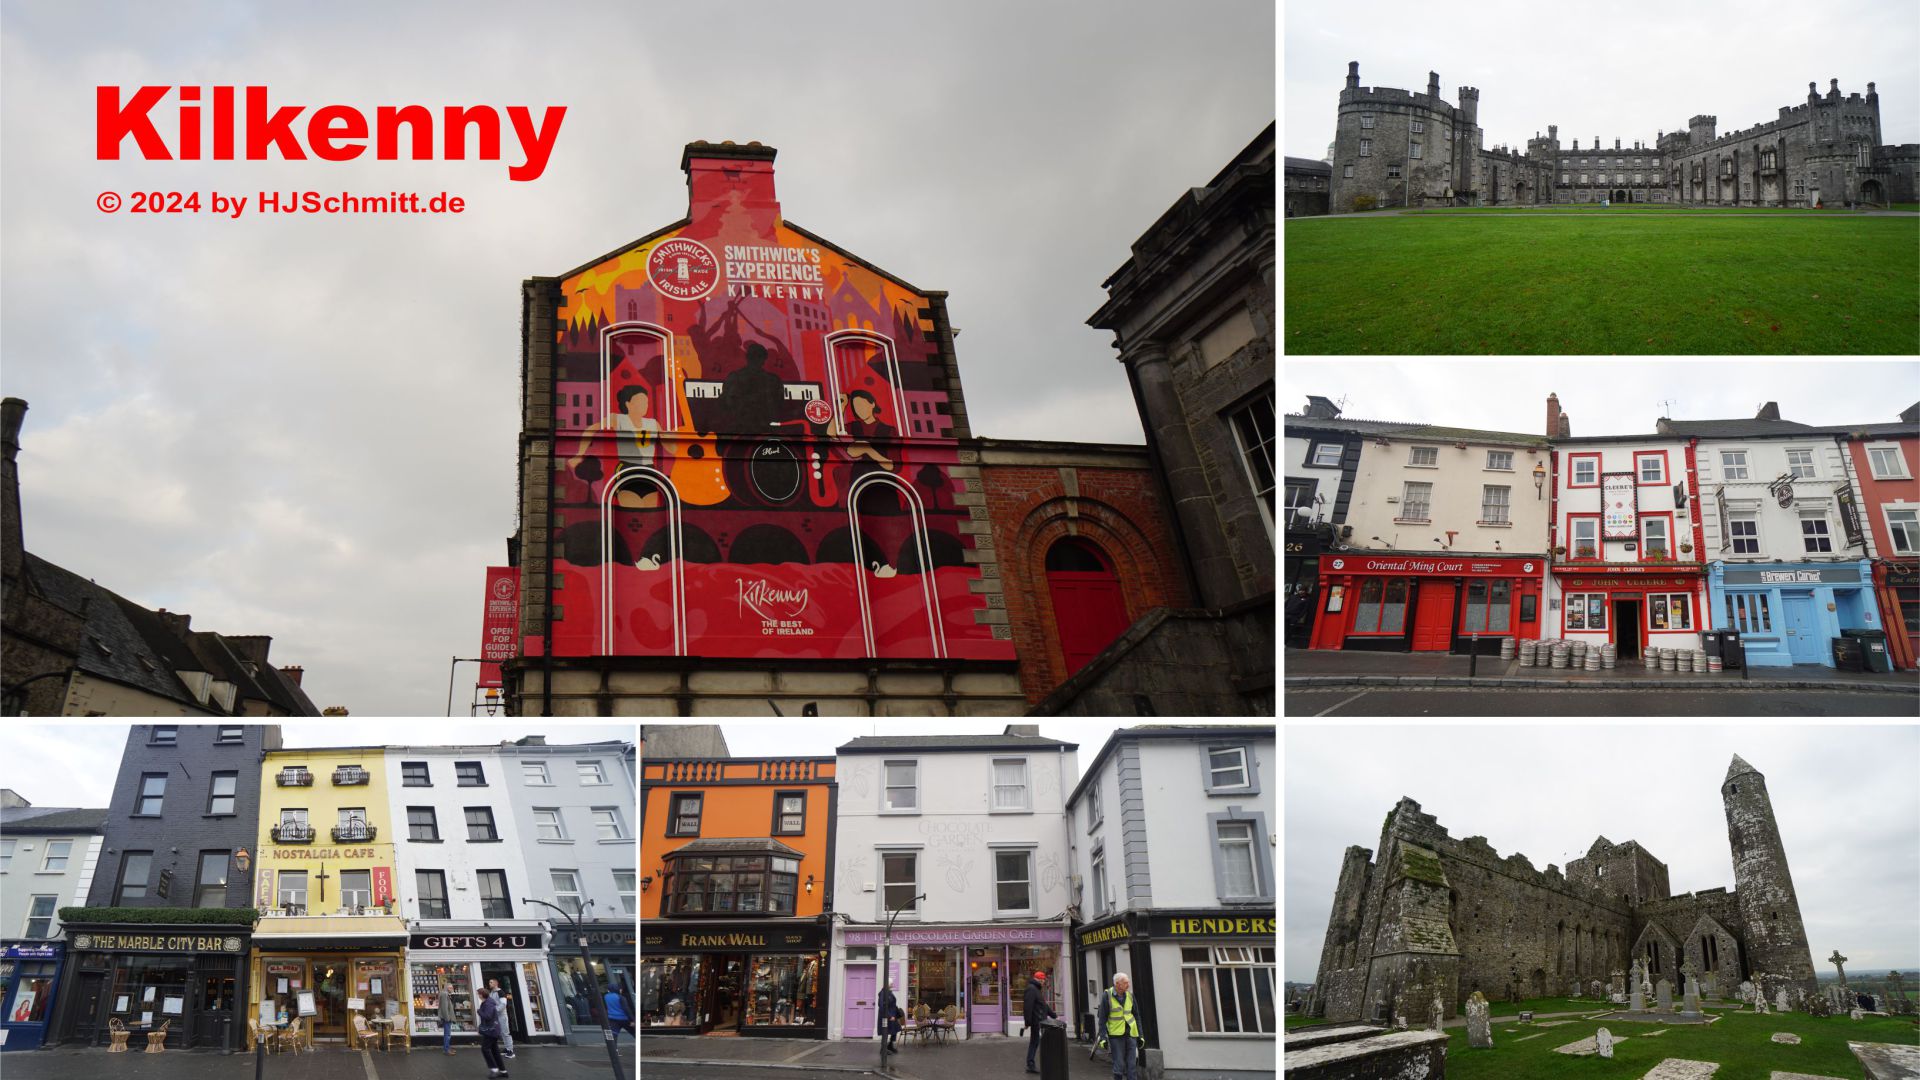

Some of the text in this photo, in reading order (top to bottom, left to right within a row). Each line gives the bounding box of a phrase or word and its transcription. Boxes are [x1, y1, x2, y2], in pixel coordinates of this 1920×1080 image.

[724, 245, 821, 263] SMITHWICK'S
[725, 261, 823, 282] EXPERIENCE
[658, 279, 709, 296] IRISH ALE
[727, 284, 824, 300] KILKENNY
[1286, 543, 1304, 552] 26
[1366, 560, 1406, 570] Oriental
[1408, 561, 1435, 572] Ming
[1437, 561, 1463, 572] Court
[1591, 578, 1619, 586] JOHN
[1766, 570, 1796, 583] Brewery
[1796, 570, 1821, 582] Corner
[736, 578, 808, 621] Kilkenny
[761, 620, 802, 628] THE BEST
[490, 627, 513, 635] OPEN
[493, 635, 510, 643] FOR
[485, 643, 517, 651] GUIDED
[487, 651, 515, 659] TOURS
[273, 848, 375, 860] NOSTALGIA CAFE
[1170, 918, 1276, 934] HENDERS
[423, 936, 527, 948] GIFTS 4 U
[682, 933, 767, 947] FRANK WALL
[849, 932, 861, 942] 98
[896, 931, 959, 941] CHOCOLATE
[962, 930, 1007, 940] GARDEN
[1082, 931, 1093, 946] THE
[92, 935, 222, 951] THE MARBLE CITY BAR
